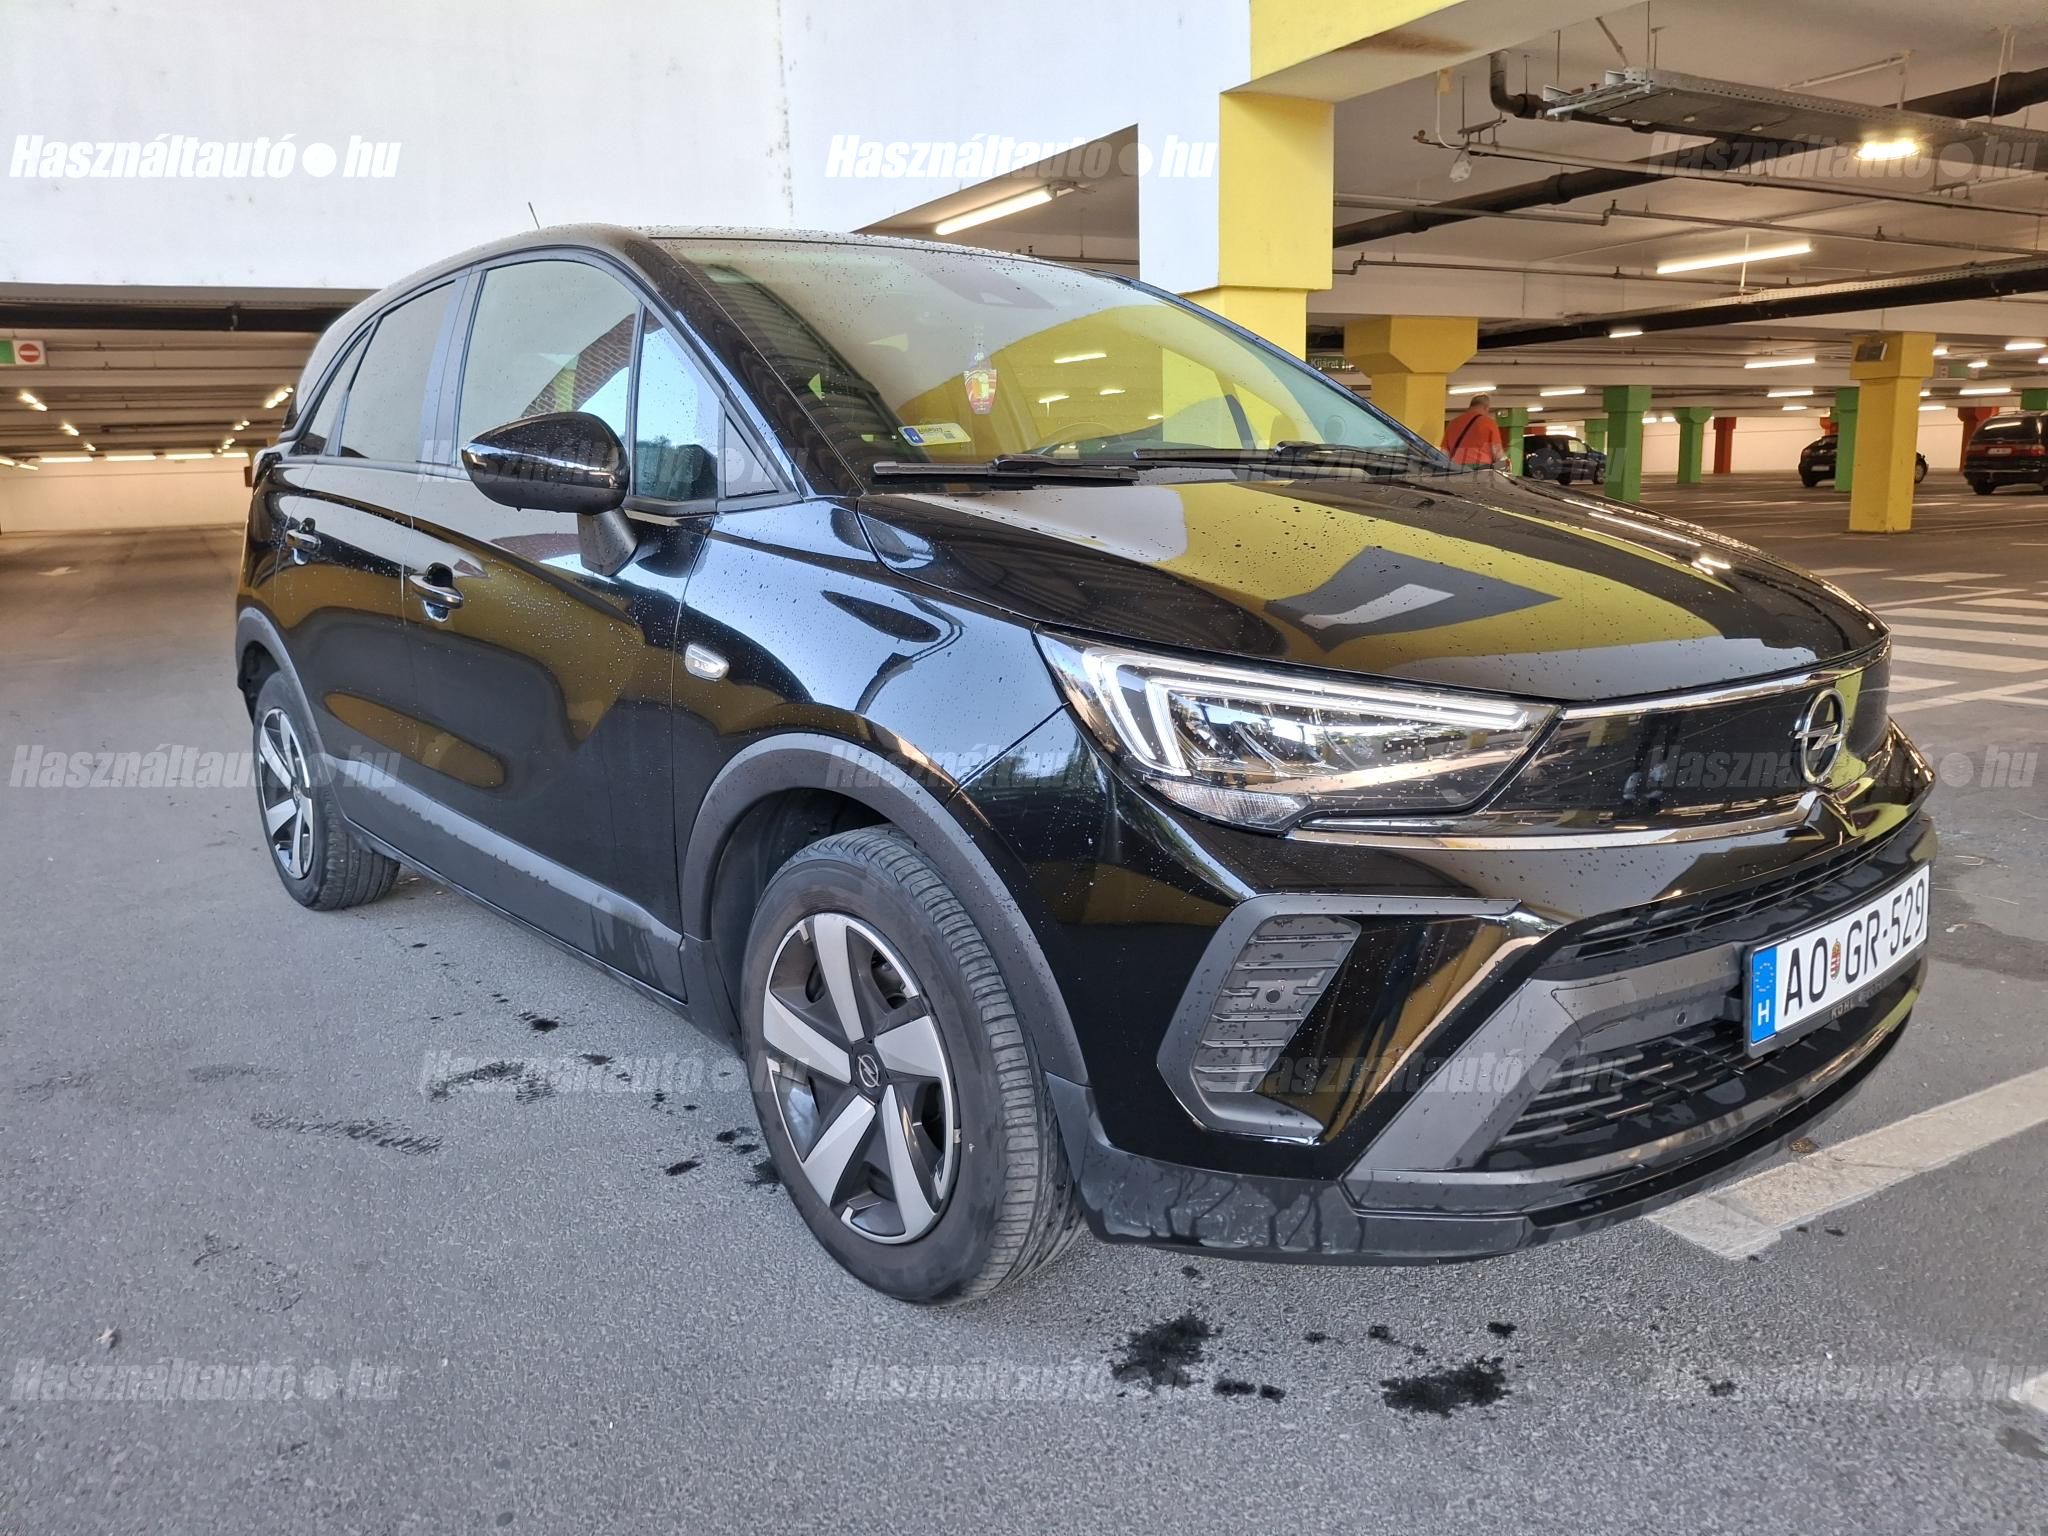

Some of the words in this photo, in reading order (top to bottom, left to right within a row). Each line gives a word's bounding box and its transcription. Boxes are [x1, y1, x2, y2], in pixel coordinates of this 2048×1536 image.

[1784, 937, 1828, 1017] AO
[1845, 878, 1925, 984] GR-529
[1757, 1000, 1770, 1026] H
